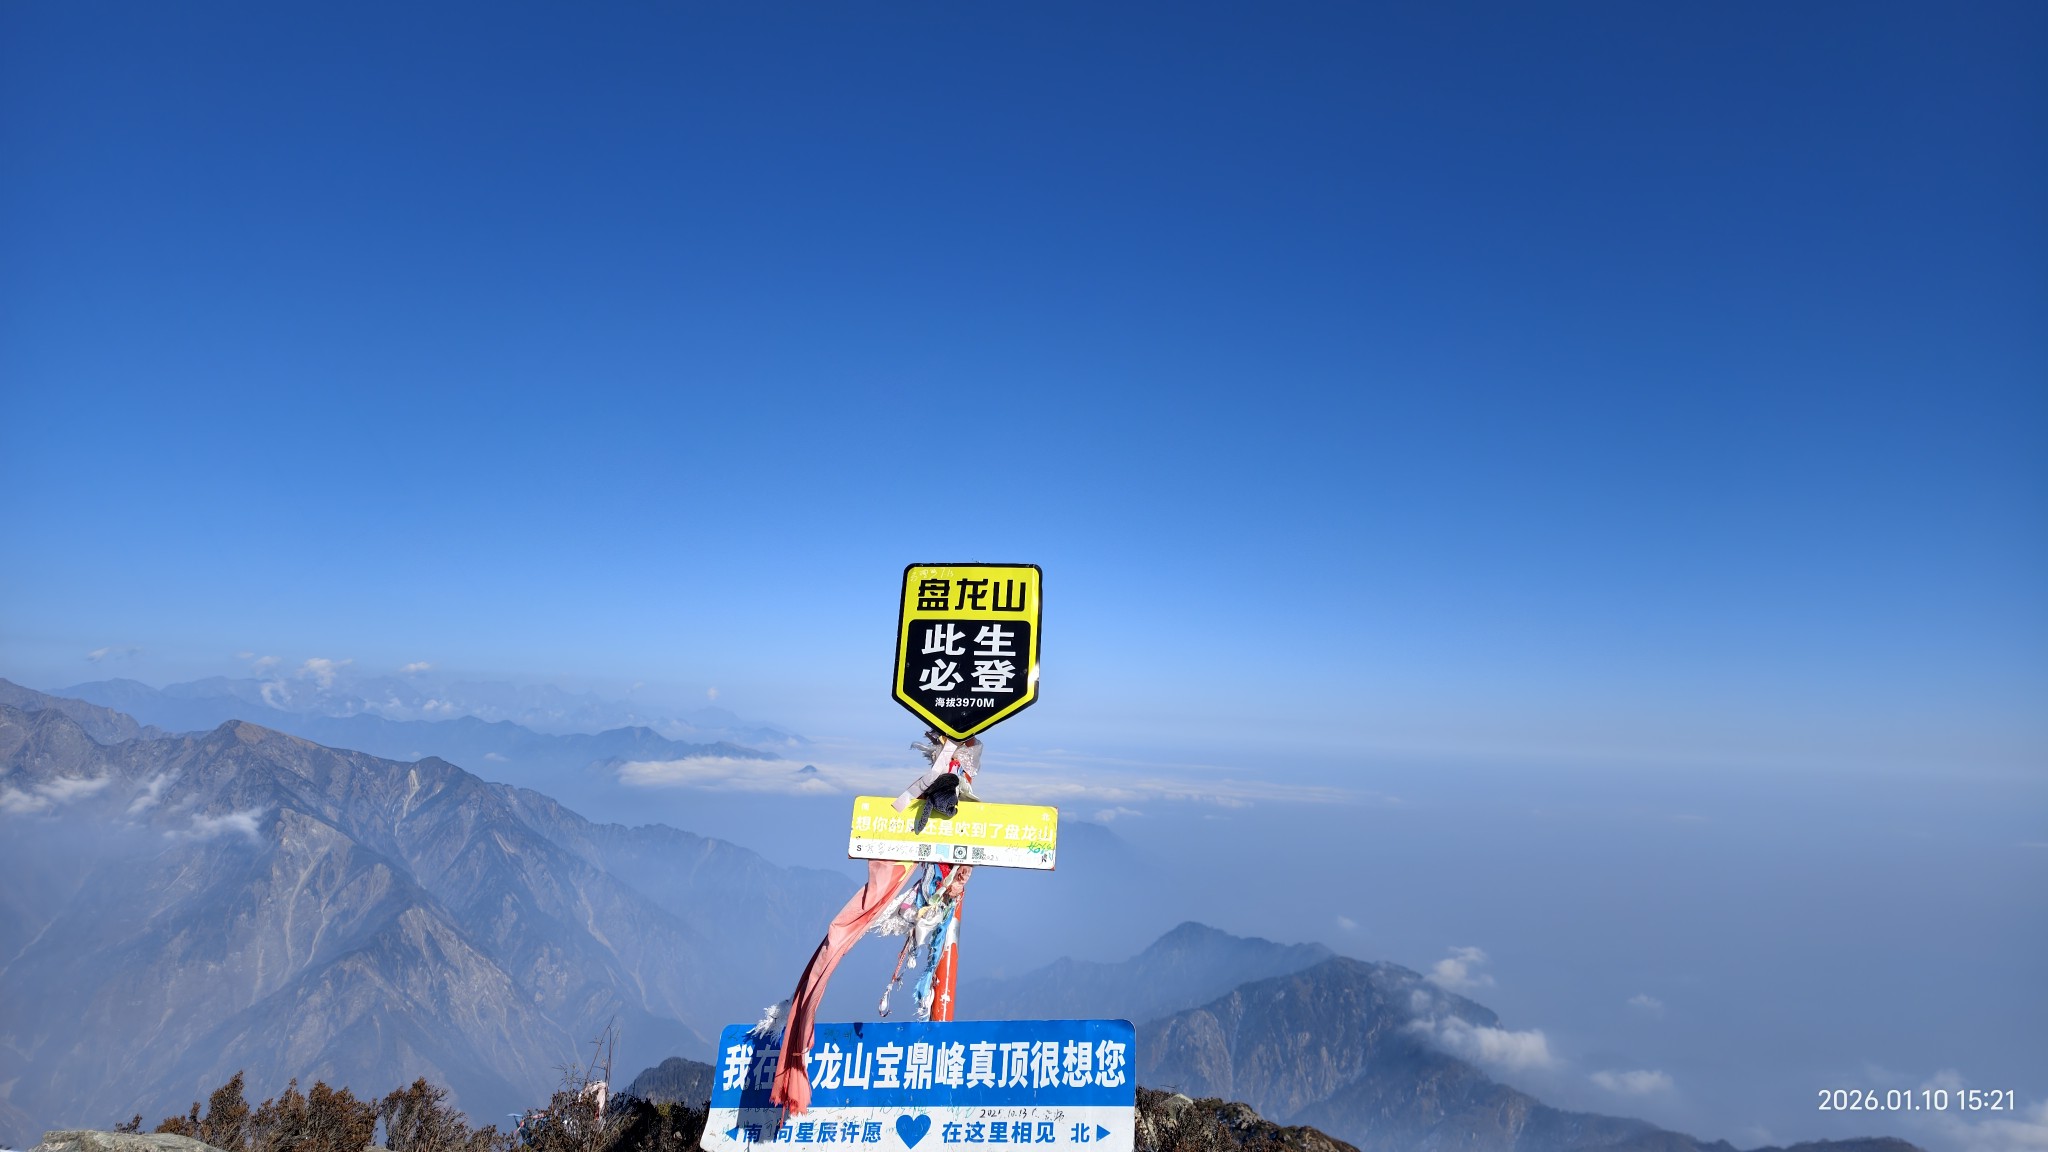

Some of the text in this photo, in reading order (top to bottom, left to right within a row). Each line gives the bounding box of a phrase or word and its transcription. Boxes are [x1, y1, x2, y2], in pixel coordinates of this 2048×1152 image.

[917, 578, 1026, 611] 盘龙山
[921, 623, 1017, 657] 此生
[919, 658, 1017, 693] 必登
[935, 697, 995, 708] 海拔3970M
[856, 844, 862, 852] S
[723, 1039, 1126, 1091] 我在龙山宝鼎峰真顶很想您
[743, 1122, 763, 1143] 南
[774, 1121, 883, 1144] 向星辰许愿
[942, 1121, 1056, 1144] 在这里相见
[1071, 1123, 1090, 1143] 北
